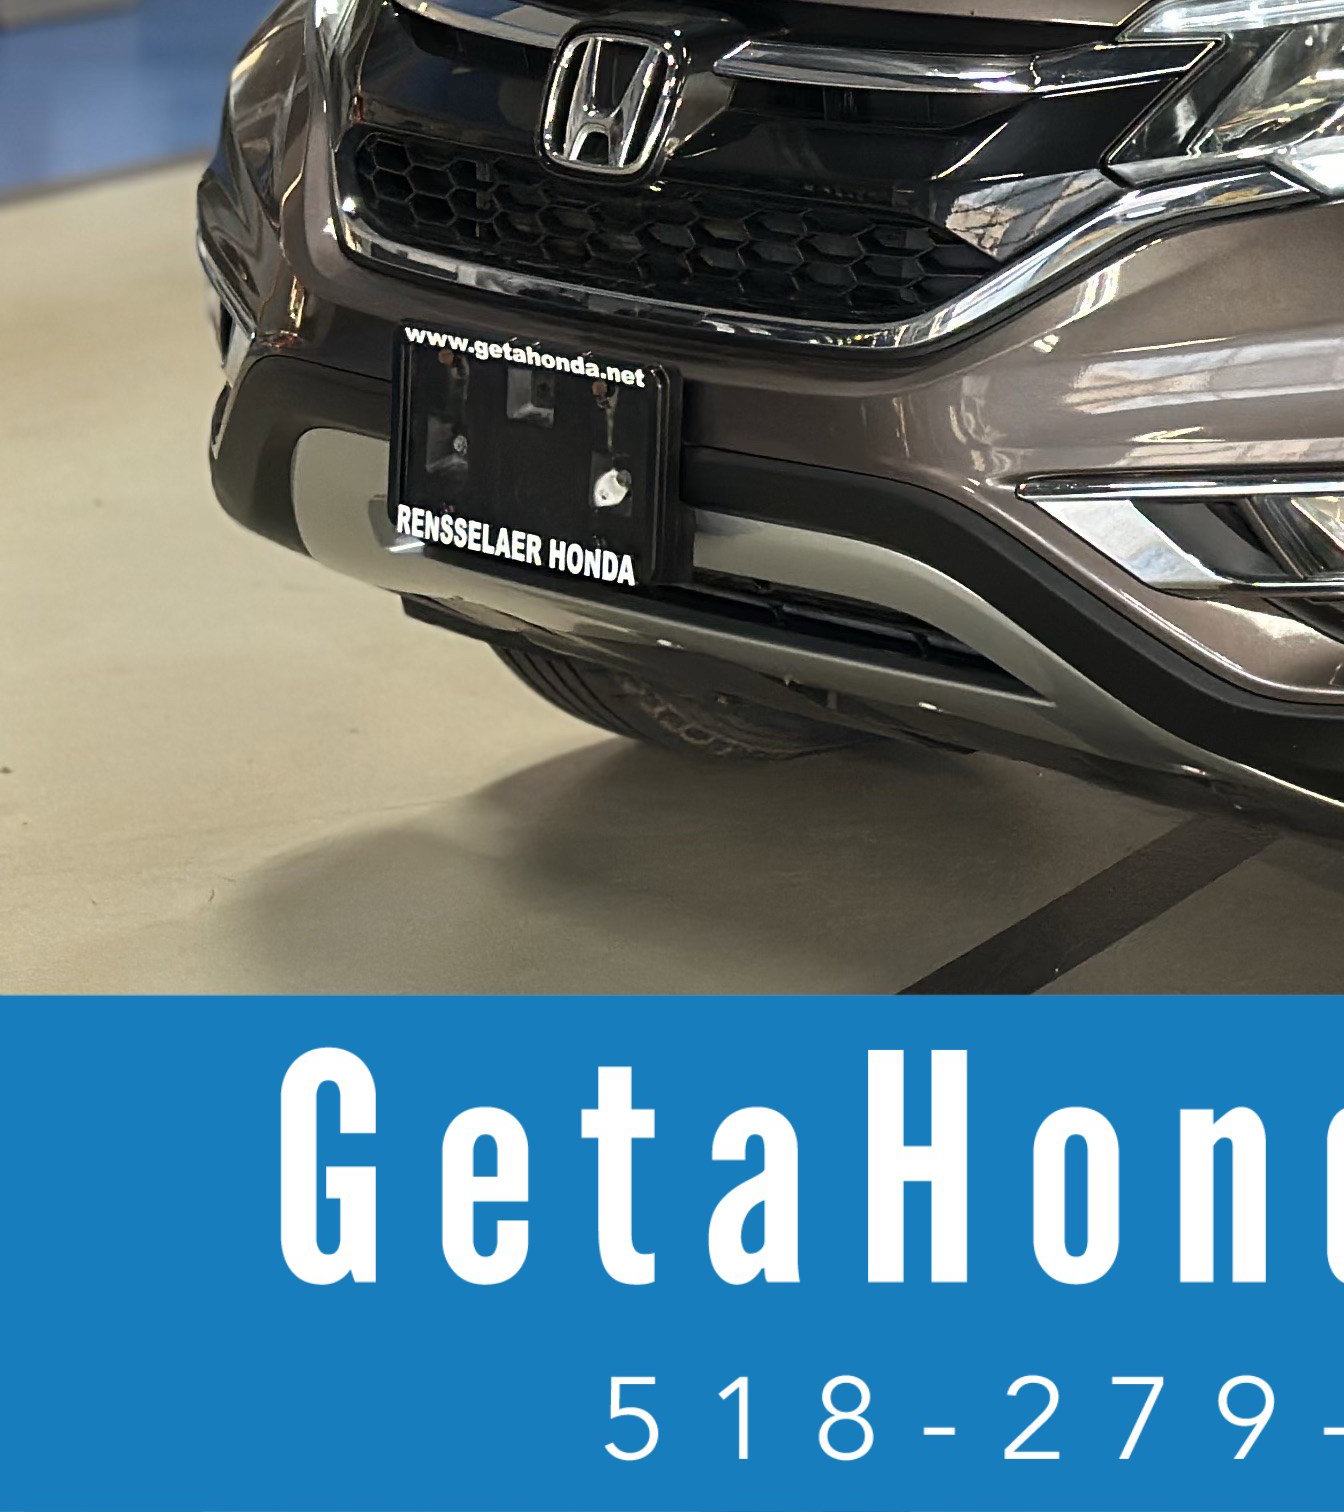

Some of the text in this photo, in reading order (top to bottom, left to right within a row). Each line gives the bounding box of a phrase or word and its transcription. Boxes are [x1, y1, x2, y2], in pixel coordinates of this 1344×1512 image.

[404, 326, 646, 388] www.getahonda.net
[396, 503, 636, 587] RENSSELAER HONDA
